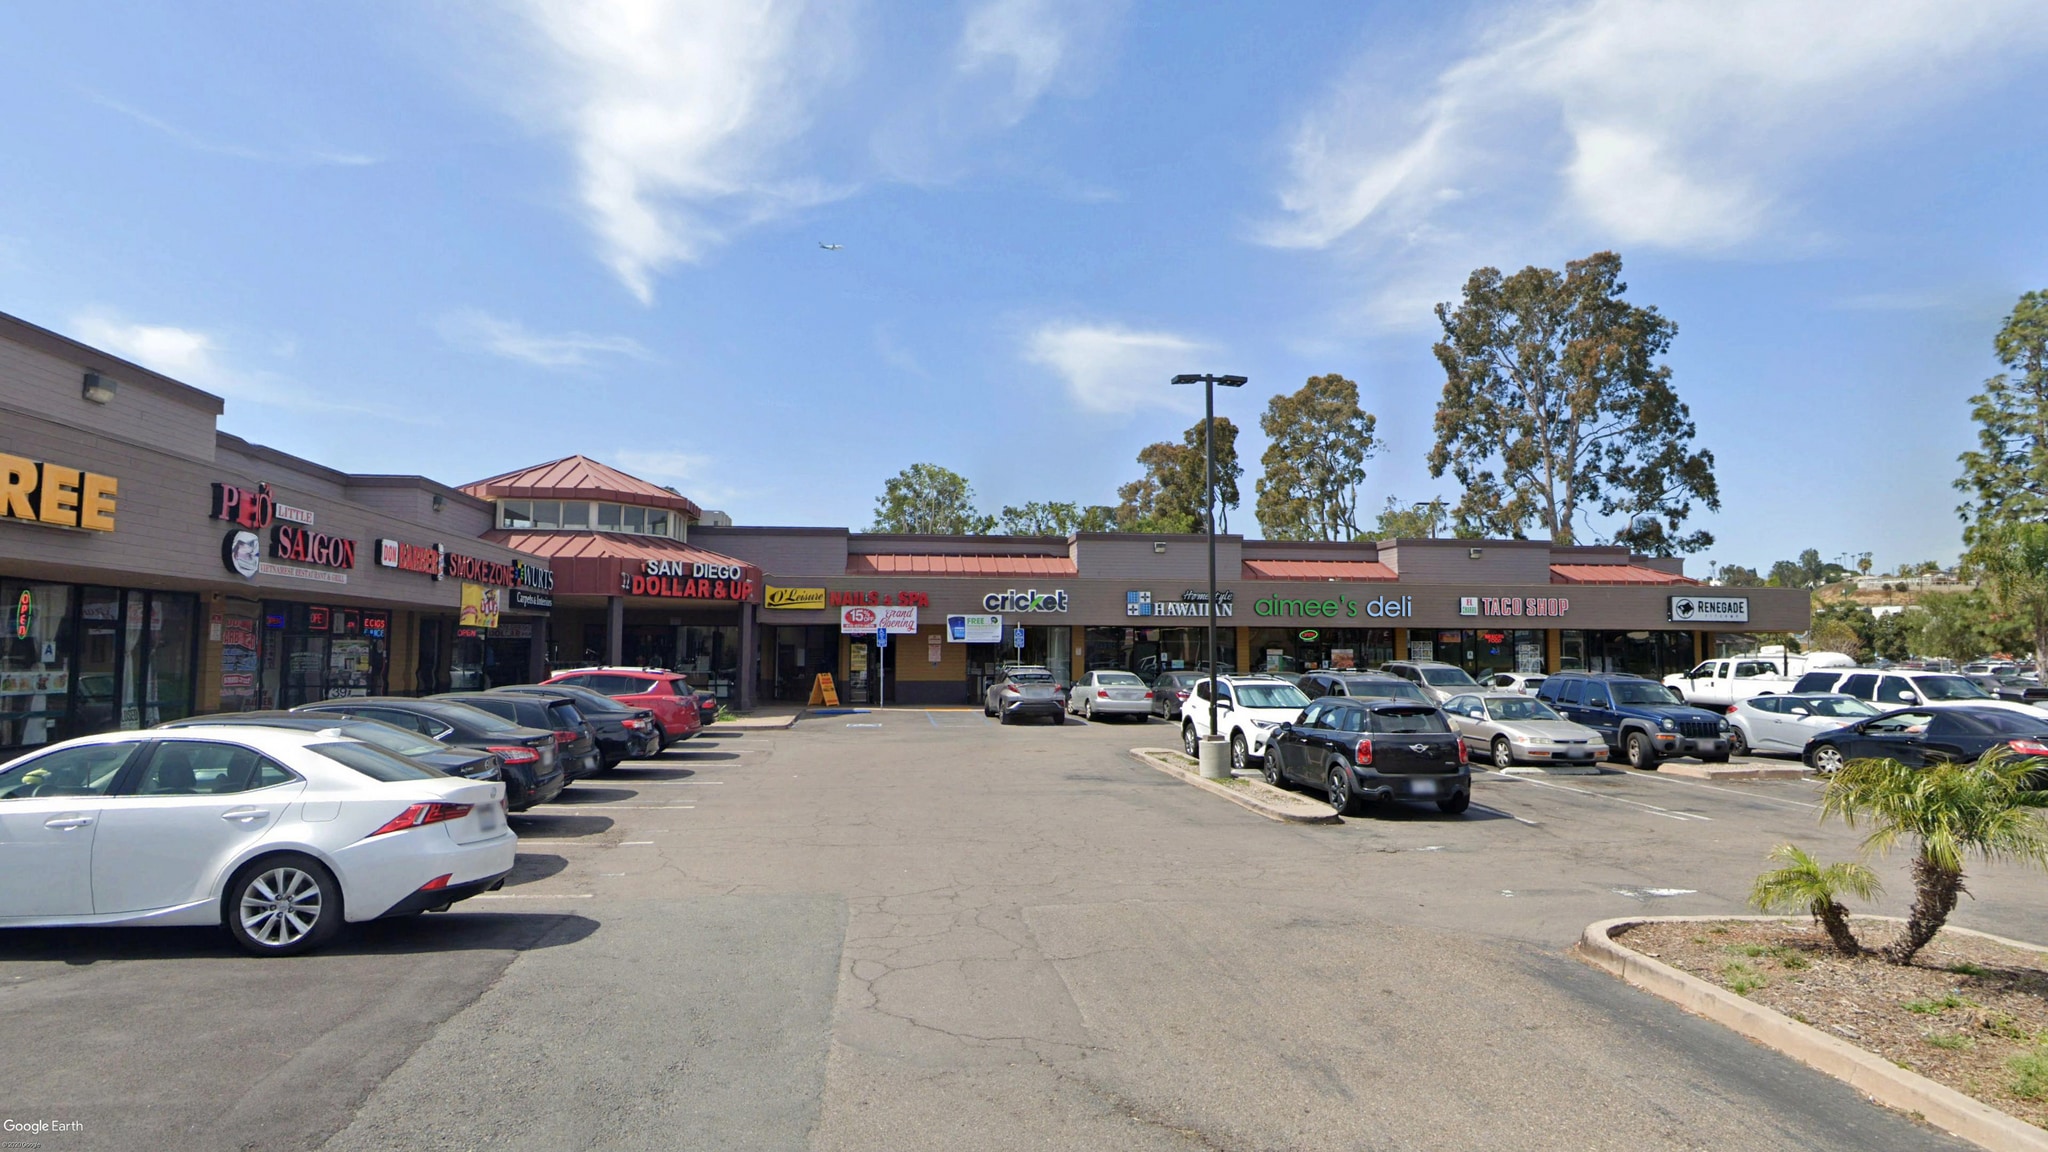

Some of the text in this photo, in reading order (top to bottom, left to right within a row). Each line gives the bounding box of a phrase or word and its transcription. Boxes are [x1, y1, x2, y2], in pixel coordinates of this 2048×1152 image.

[278, 505, 312, 524] LITTLE
[277, 525, 357, 569] SAIGON
[383, 544, 397, 562] DON
[524, 564, 554, 591] WURTS
[646, 560, 741, 580] SAN DIEGO
[631, 575, 753, 600] DOLLAR & UP
[769, 589, 824, 604] O'Leisure
[829, 591, 929, 608] NAILS & SPA
[983, 589, 1068, 612] cricket
[1255, 593, 1412, 617] aimee's deli
[1482, 597, 1569, 617] TACO SHOP
[1698, 601, 1745, 613] RENEGADE
[885, 608, 914, 620] Grand
[967, 617, 985, 625] FREE
[879, 618, 915, 631] Opening
[44, 644, 53, 655] A
